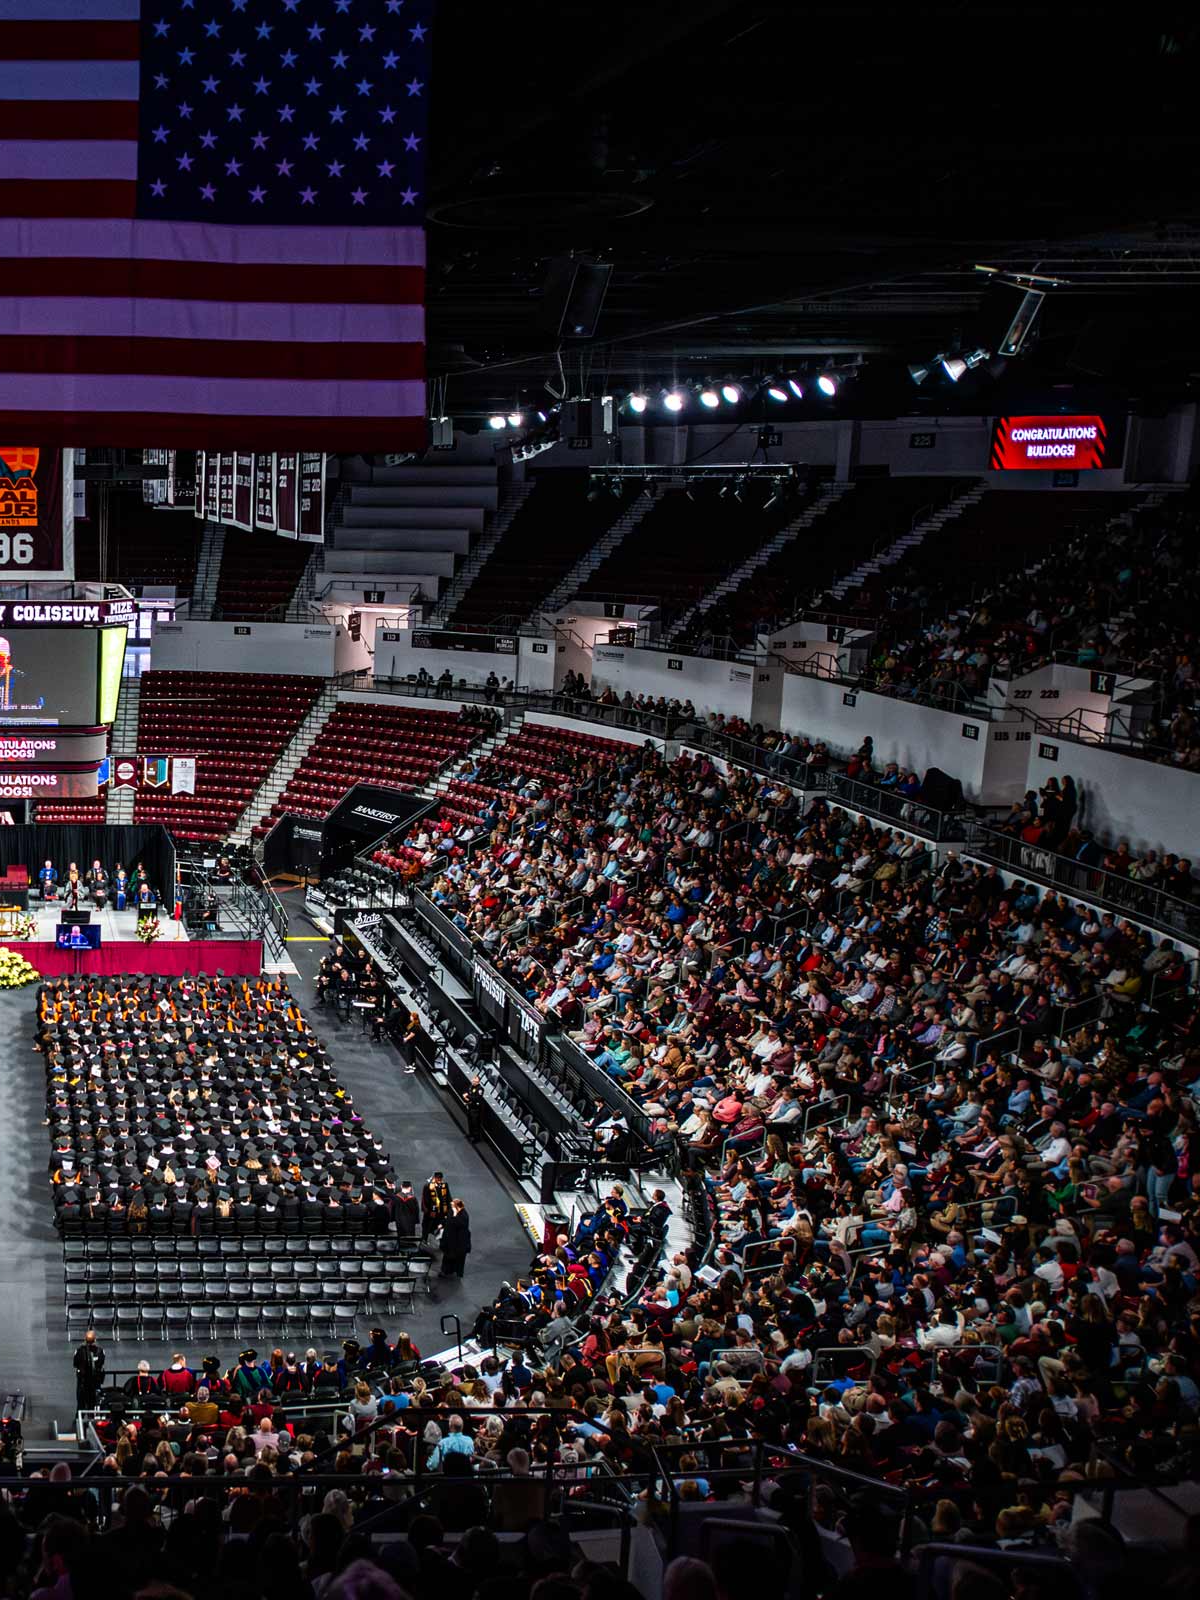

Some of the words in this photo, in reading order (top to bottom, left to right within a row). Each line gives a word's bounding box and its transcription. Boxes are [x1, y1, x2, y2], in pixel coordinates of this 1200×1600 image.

[1011, 426, 1097, 441] CONGRATULATIONS
[1026, 444, 1076, 457] BULLDOGS!
[370, 592, 378, 602] H
[13, 605, 99, 622] COLISEUM
[110, 601, 133, 614] MIZE
[1097, 674, 1108, 691] K
[1014, 689, 1031, 699] 227
[1040, 689, 1059, 699] 228
[354, 805, 401, 822] BANKFIRST
[354, 911, 383, 928] State
